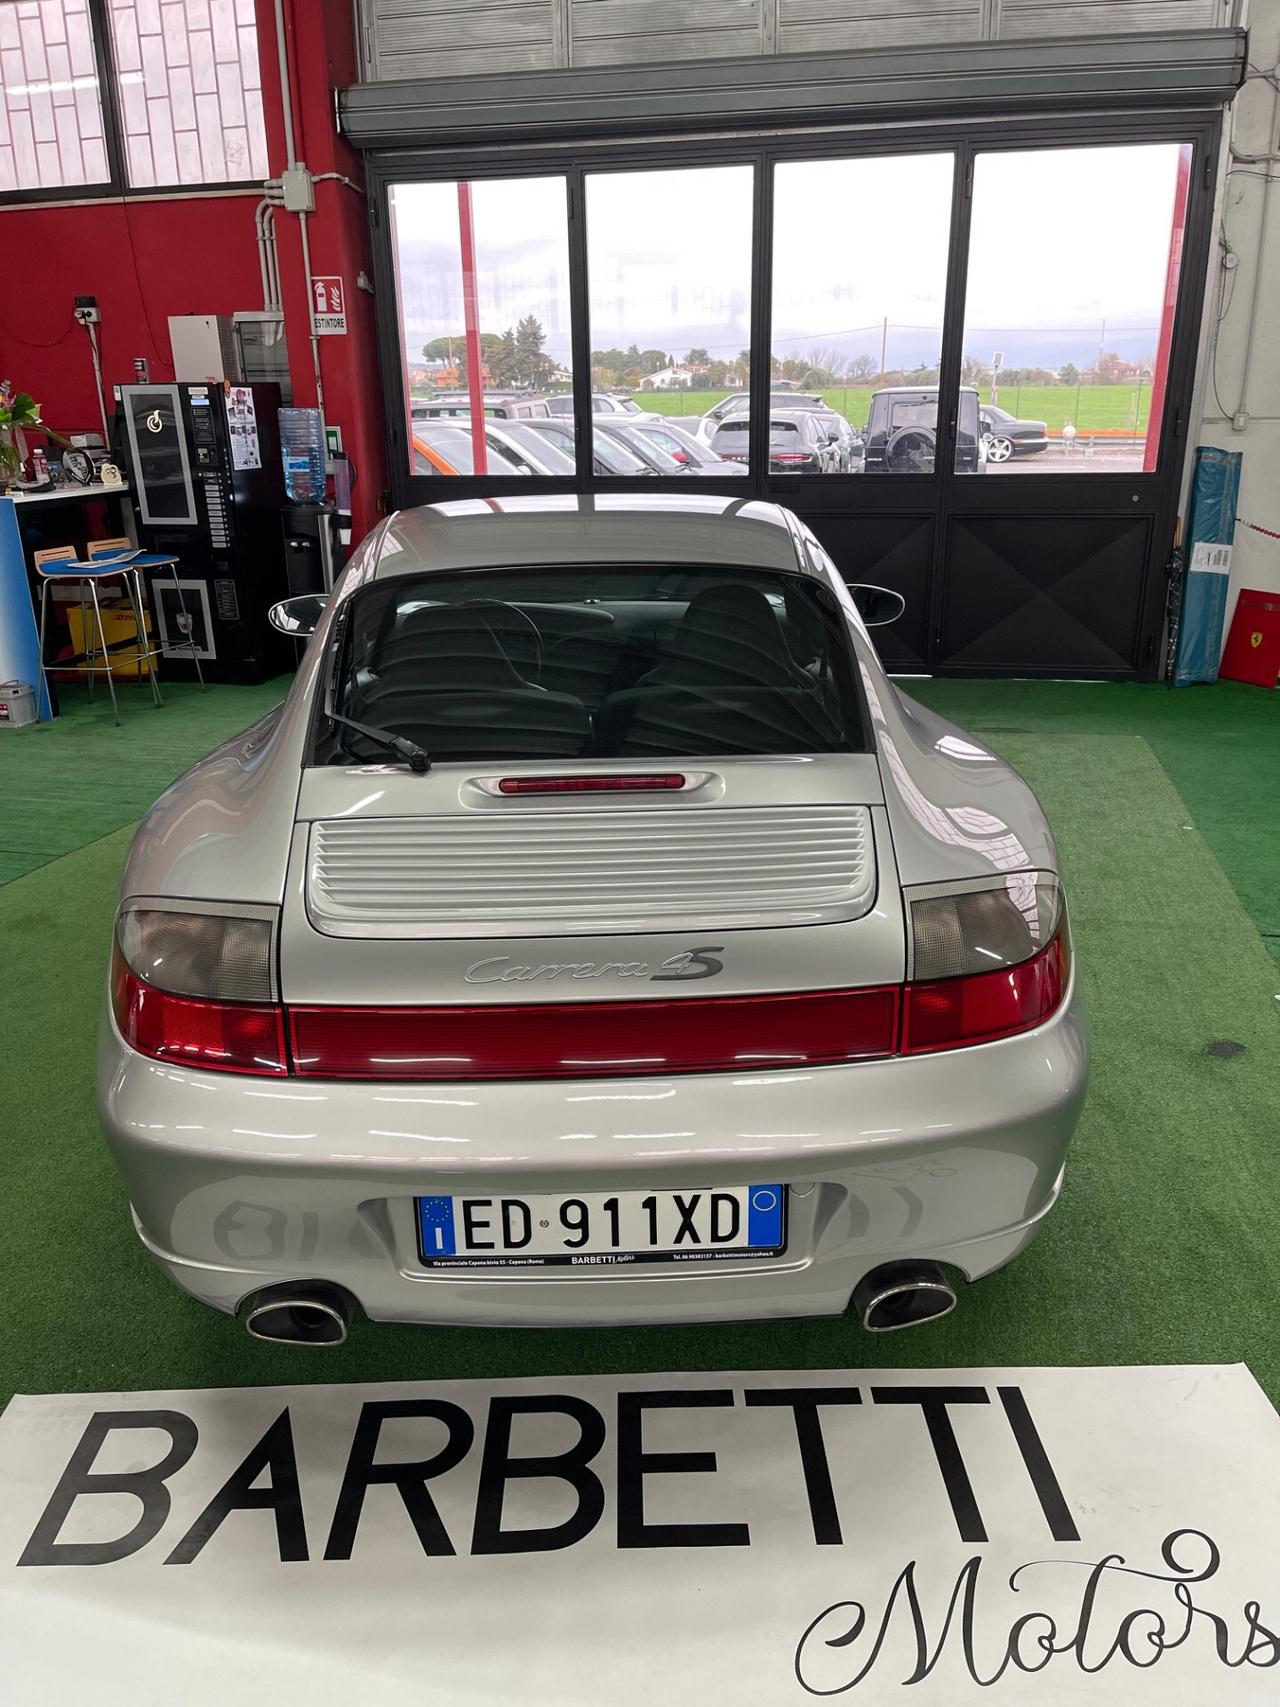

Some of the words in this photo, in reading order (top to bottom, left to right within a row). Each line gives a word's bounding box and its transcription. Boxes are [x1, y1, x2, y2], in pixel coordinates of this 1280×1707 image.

[314, 318, 345, 328] ESTINTORE
[464, 956, 648, 983] Carrera
[650, 946, 725, 981] 4S
[462, 1199, 532, 1250] ED
[559, 1193, 741, 1248] 911XD
[571, 1255, 616, 1264] BARBETTI
[16, 1386, 1081, 1567] BARBETTI
[794, 1528, 1280, 1696] Motors
